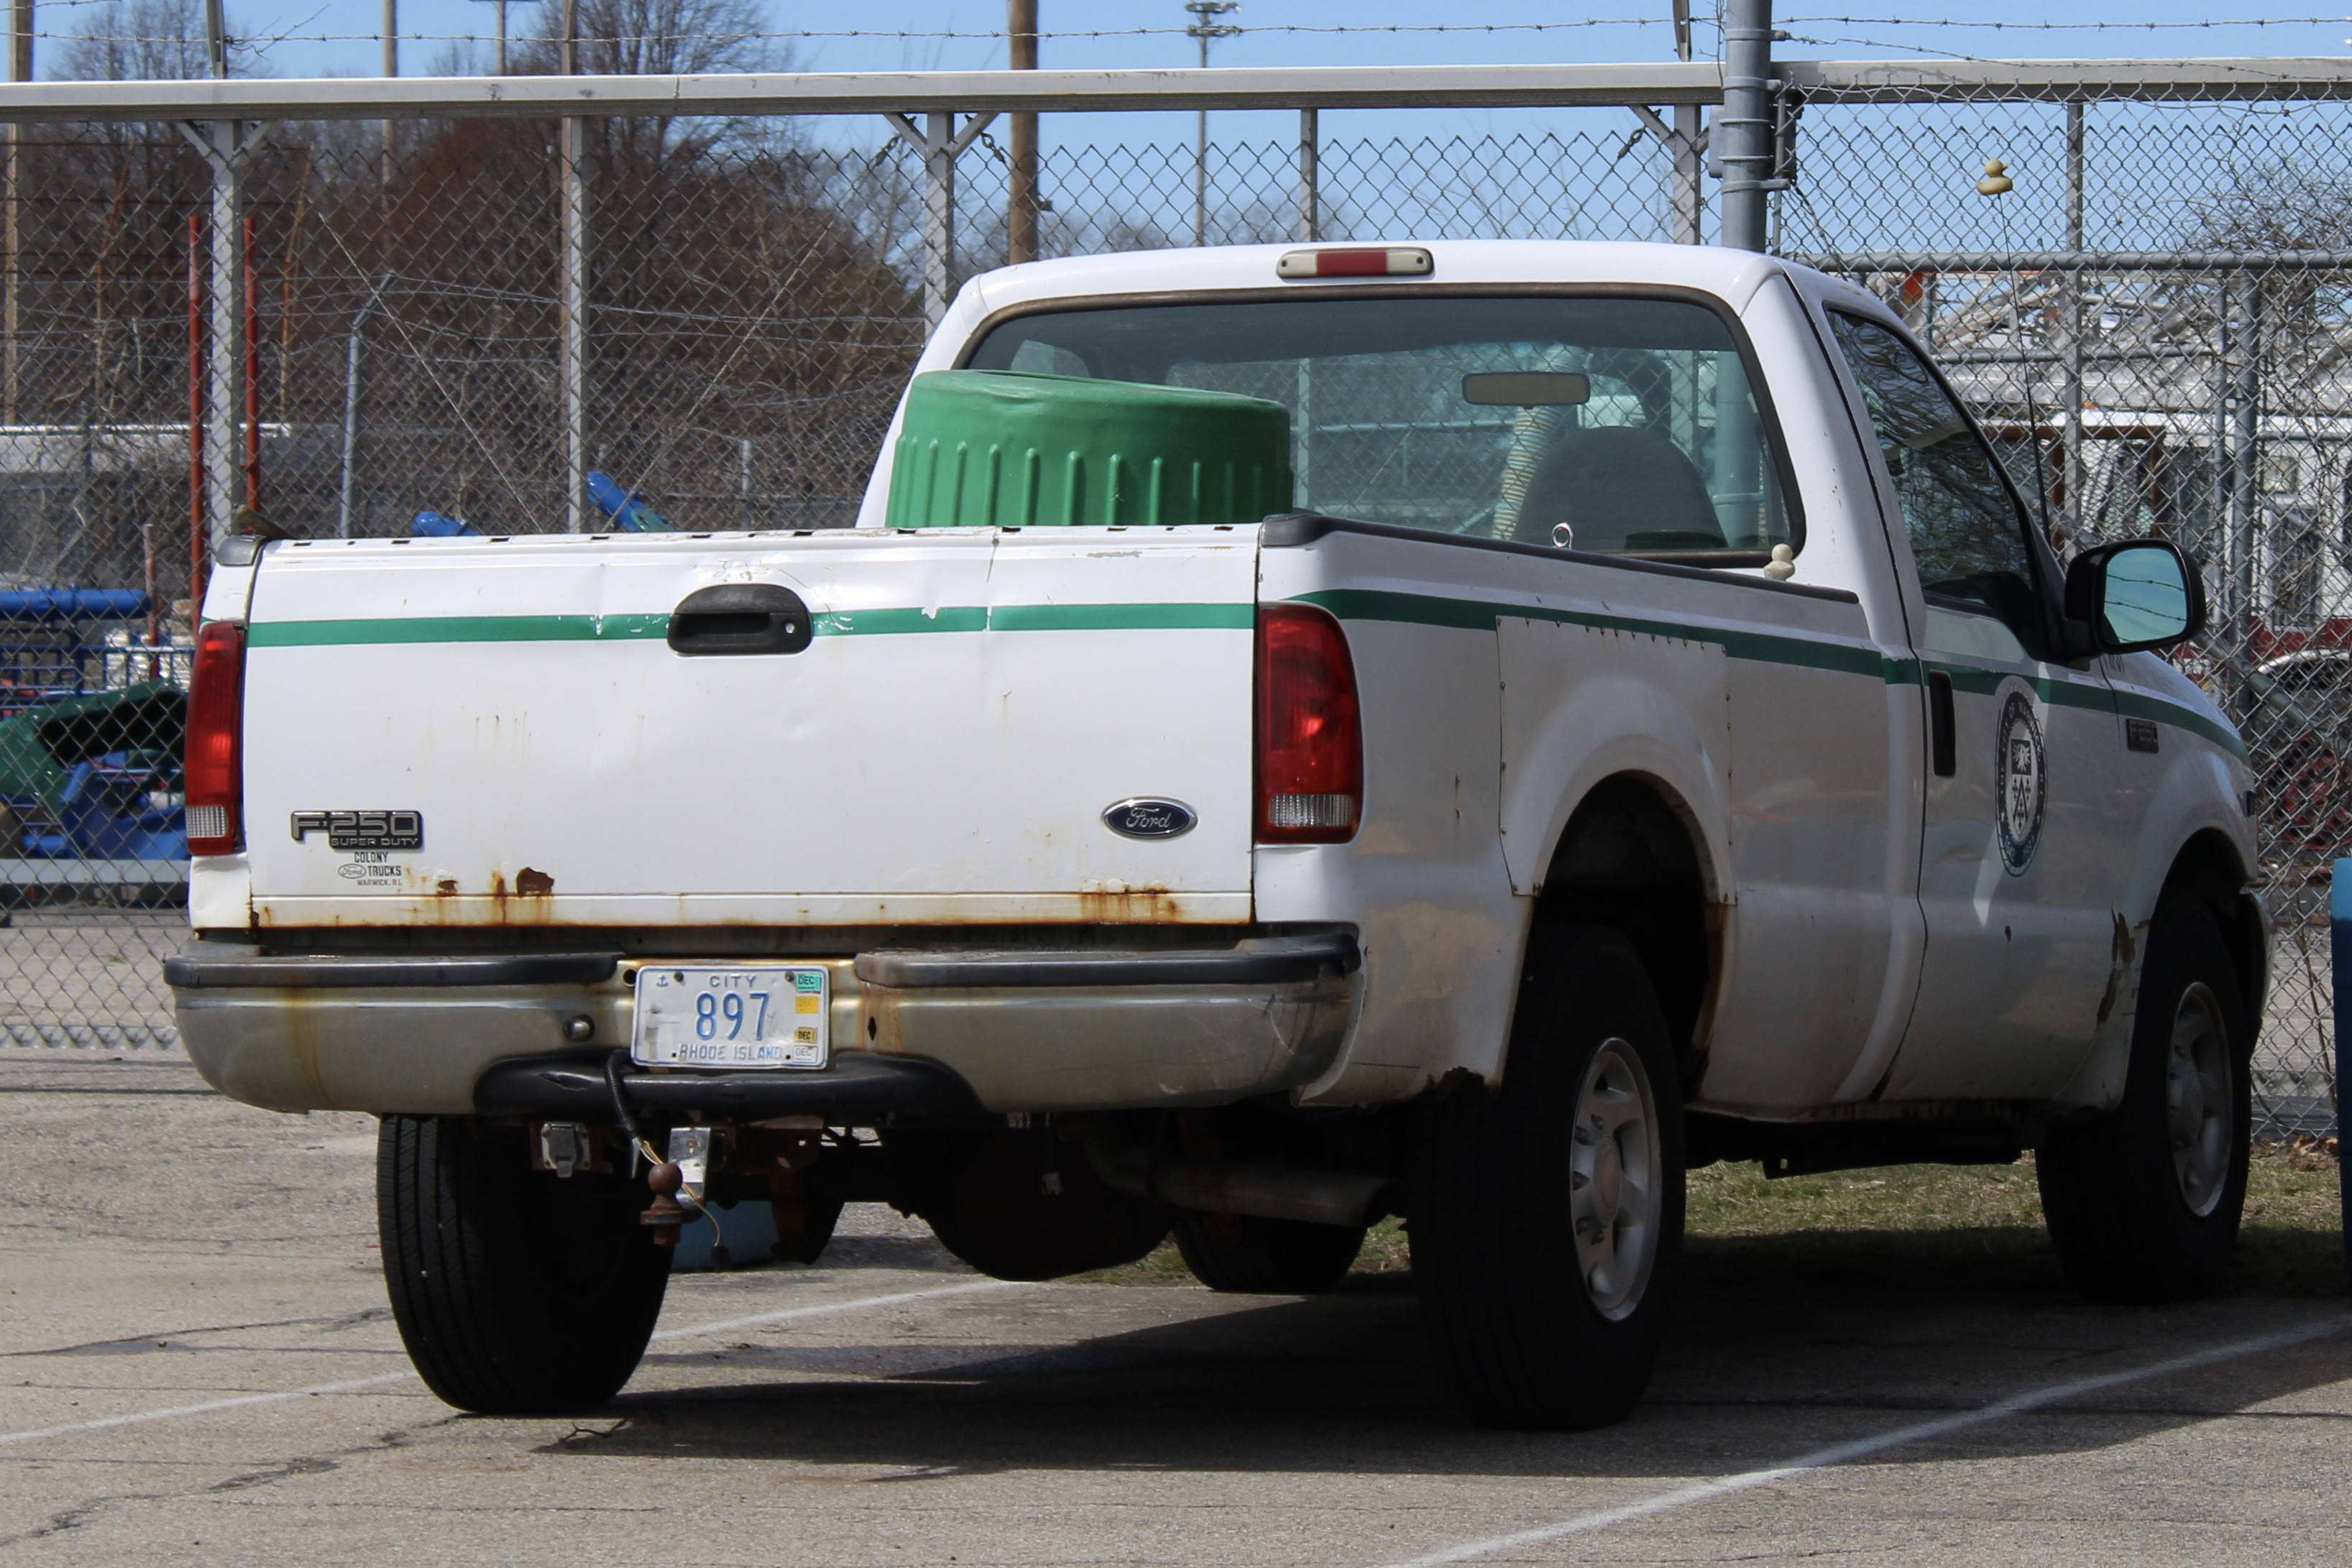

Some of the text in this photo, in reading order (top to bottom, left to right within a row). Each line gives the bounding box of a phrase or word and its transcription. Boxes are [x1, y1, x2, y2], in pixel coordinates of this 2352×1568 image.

[1126, 807, 1172, 828] Ford
[291, 811, 418, 839] F-250
[331, 837, 377, 846] SUPER
[354, 852, 389, 863] COLONY
[368, 865, 402, 877] TRUCKS
[709, 975, 757, 988] CITY
[797, 975, 815, 985] DEC
[695, 990, 770, 1041] 897
[797, 1030, 812, 1041] DEC
[678, 1043, 782, 1061] RHODE ISLAND
[795, 1046, 812, 1056] DEC
